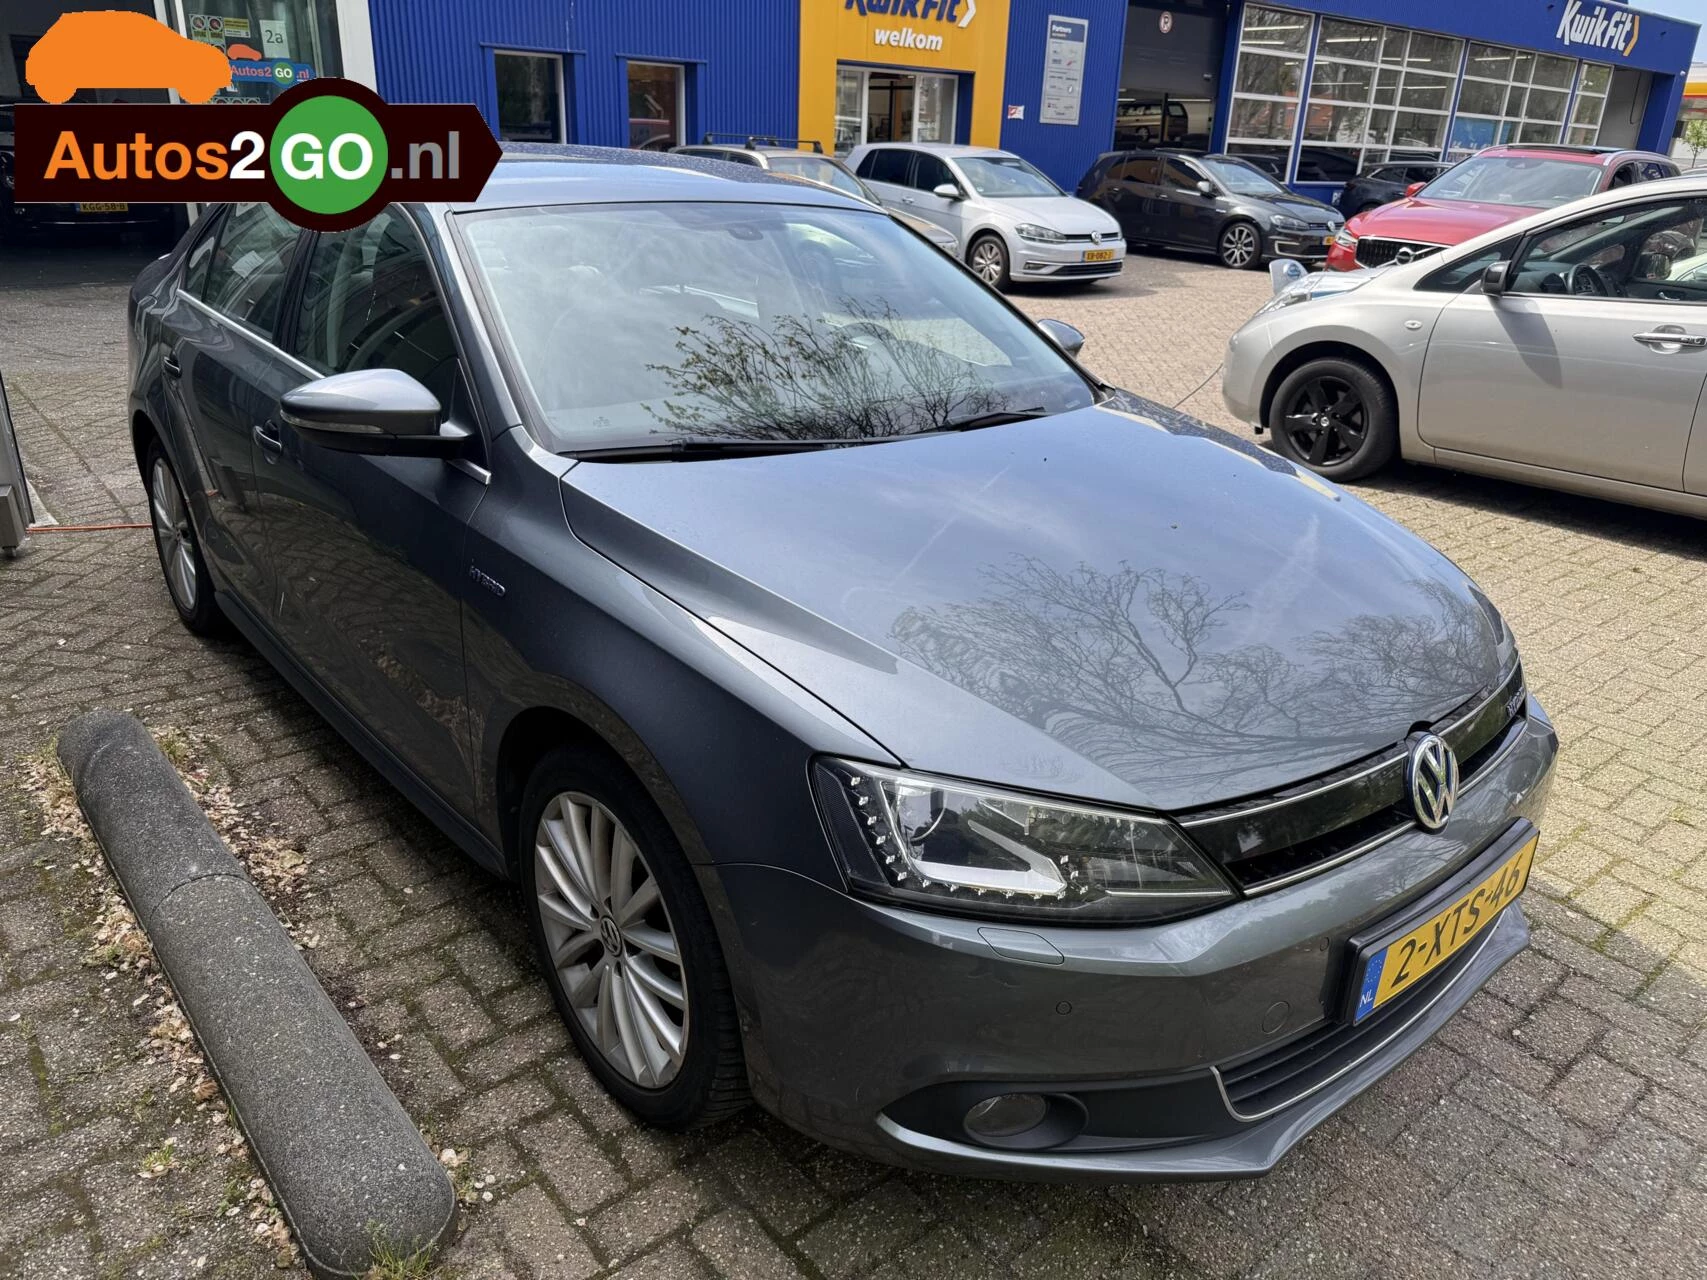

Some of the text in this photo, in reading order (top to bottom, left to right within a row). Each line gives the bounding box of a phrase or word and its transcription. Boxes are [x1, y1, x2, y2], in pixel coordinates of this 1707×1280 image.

[265, 29, 284, 44] 2a
[874, 27, 943, 51] welkom
[1390, 853, 1523, 989] 2-XTS-46
[1359, 989, 1374, 1008] NL
